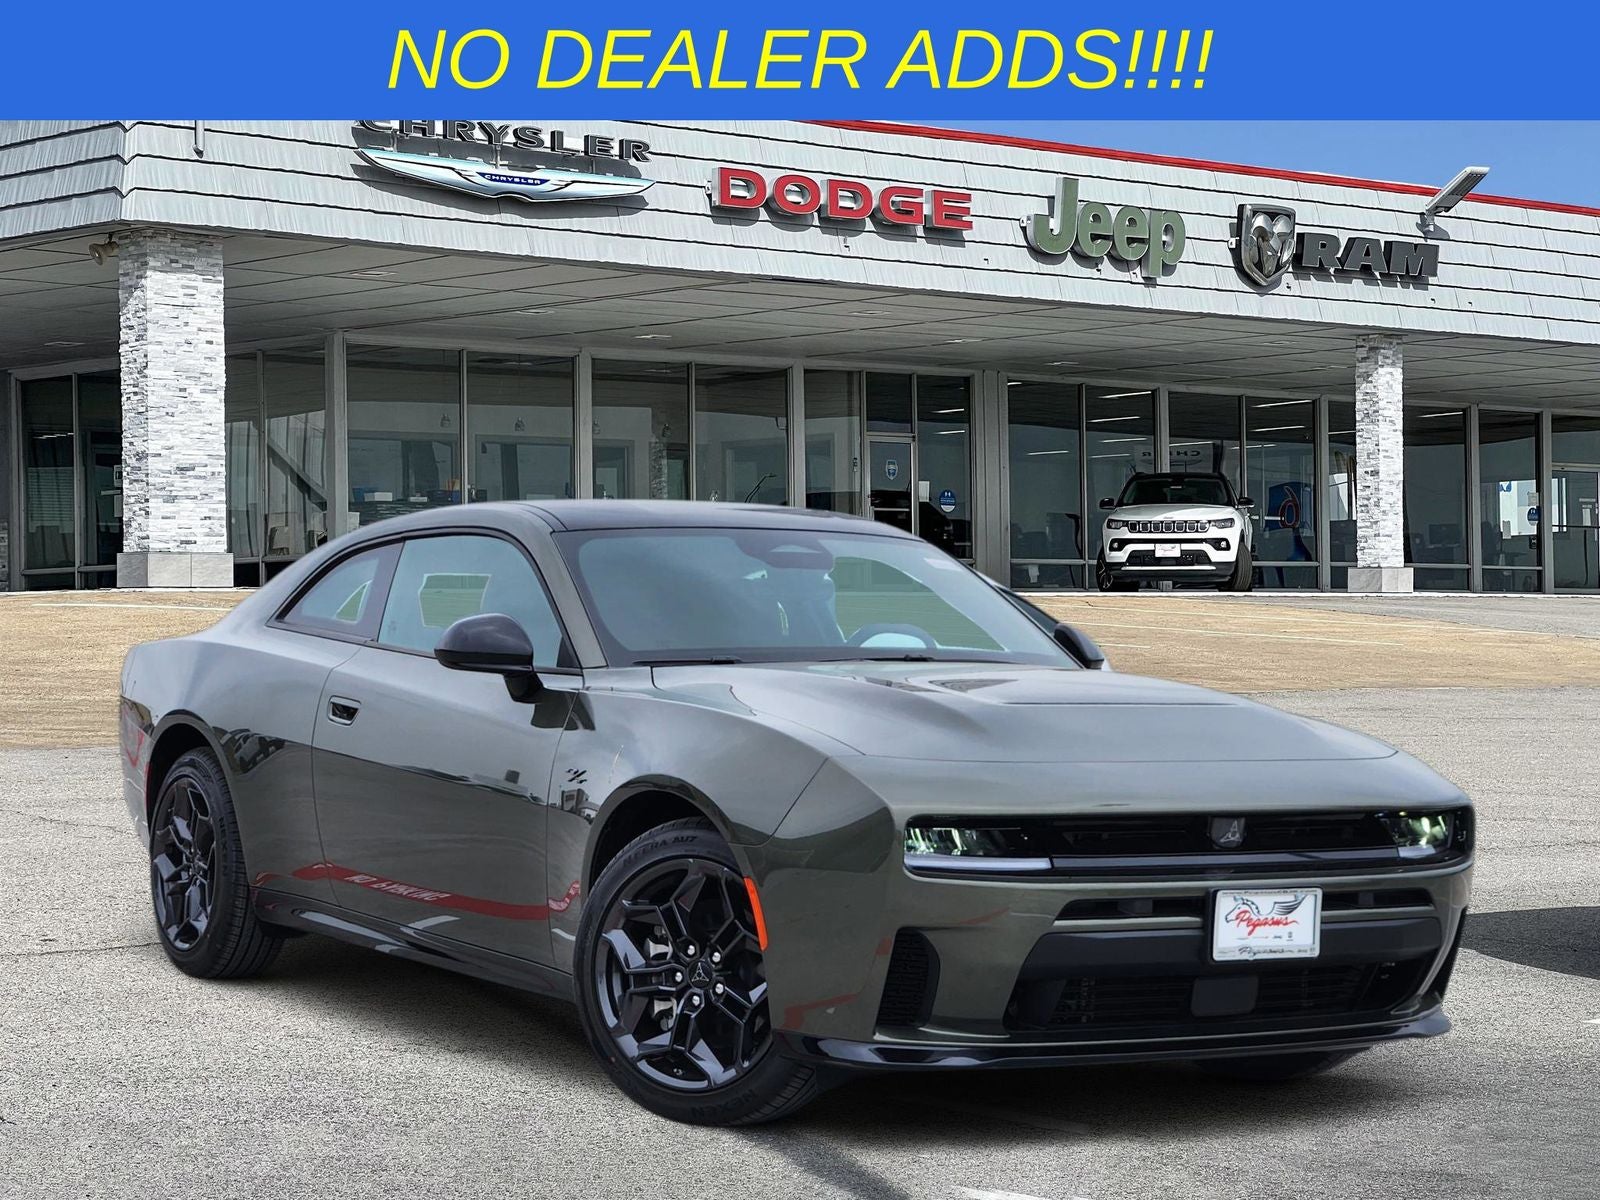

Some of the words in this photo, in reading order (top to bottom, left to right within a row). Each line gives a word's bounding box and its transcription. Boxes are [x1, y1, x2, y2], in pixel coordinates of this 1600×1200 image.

[484, 174, 541, 185] CHRYSLER
[711, 166, 974, 231] DODGE
[1026, 177, 1186, 278] Jeep
[1299, 232, 1439, 278] RAM
[1235, 909, 1299, 937] Pegasus
